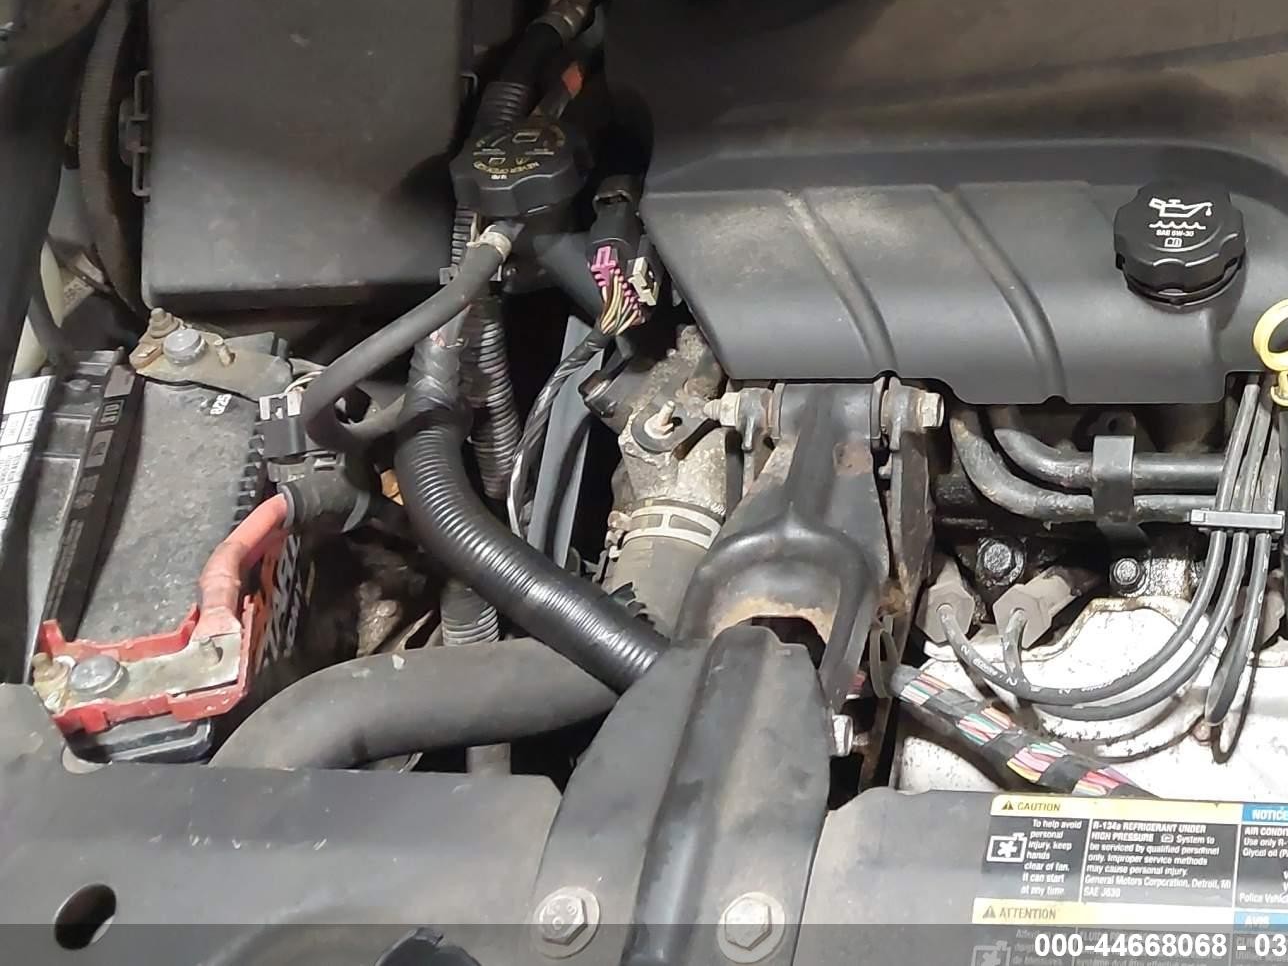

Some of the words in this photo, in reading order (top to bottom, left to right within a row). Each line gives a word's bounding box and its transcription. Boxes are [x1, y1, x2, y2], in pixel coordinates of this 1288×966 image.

[1017, 802, 1061, 811] CAUTION
[1033, 819, 1041, 828] To
[1043, 820, 1060, 829] help
[1061, 820, 1082, 829] avoid
[1092, 821, 1121, 831] R-134a
[1123, 822, 1177, 833] REFRIGERANT
[1178, 824, 1207, 834] UNDER
[1030, 830, 1064, 840] personal
[1244, 827, 1258, 836] AIR
[1091, 832, 1112, 841] HIGH
[1112, 832, 1154, 842] PRESSURE
[1176, 834, 1205, 844] System
[1206, 836, 1215, 844] to
[1244, 837, 1258, 846] Use
[1260, 838, 1276, 848] only
[1052, 841, 1072, 851] keep
[1089, 842, 1100, 851] be
[1101, 844, 1134, 852] serviced
[1135, 844, 1145, 854] by
[1146, 845, 1180, 854] qualified
[1181, 846, 1220, 856] personnel
[1026, 850, 1050, 860] hands
[1242, 848, 1266, 858] Glycol
[1268, 850, 1278, 858] oil
[1108, 854, 1143, 864] Improper
[1144, 855, 1172, 864] service
[1174, 856, 1208, 865] methods
[1024, 862, 1044, 871] clear
[1045, 862, 1054, 870] of
[1086, 865, 1104, 875] may
[1104, 866, 1128, 874] cause
[1130, 866, 1163, 876] personal
[1030, 874, 1045, 883] can
[1046, 874, 1065, 883] start
[1084, 874, 1114, 884] General
[1115, 876, 1143, 886] Motors
[1221, 880, 1231, 889] MI
[1020, 885, 1029, 894] at
[1030, 886, 1046, 896] any
[1083, 886, 1100, 897] SAE
[1240, 892, 1263, 903] Police
[1000, 907, 1056, 920] ATTENTION
